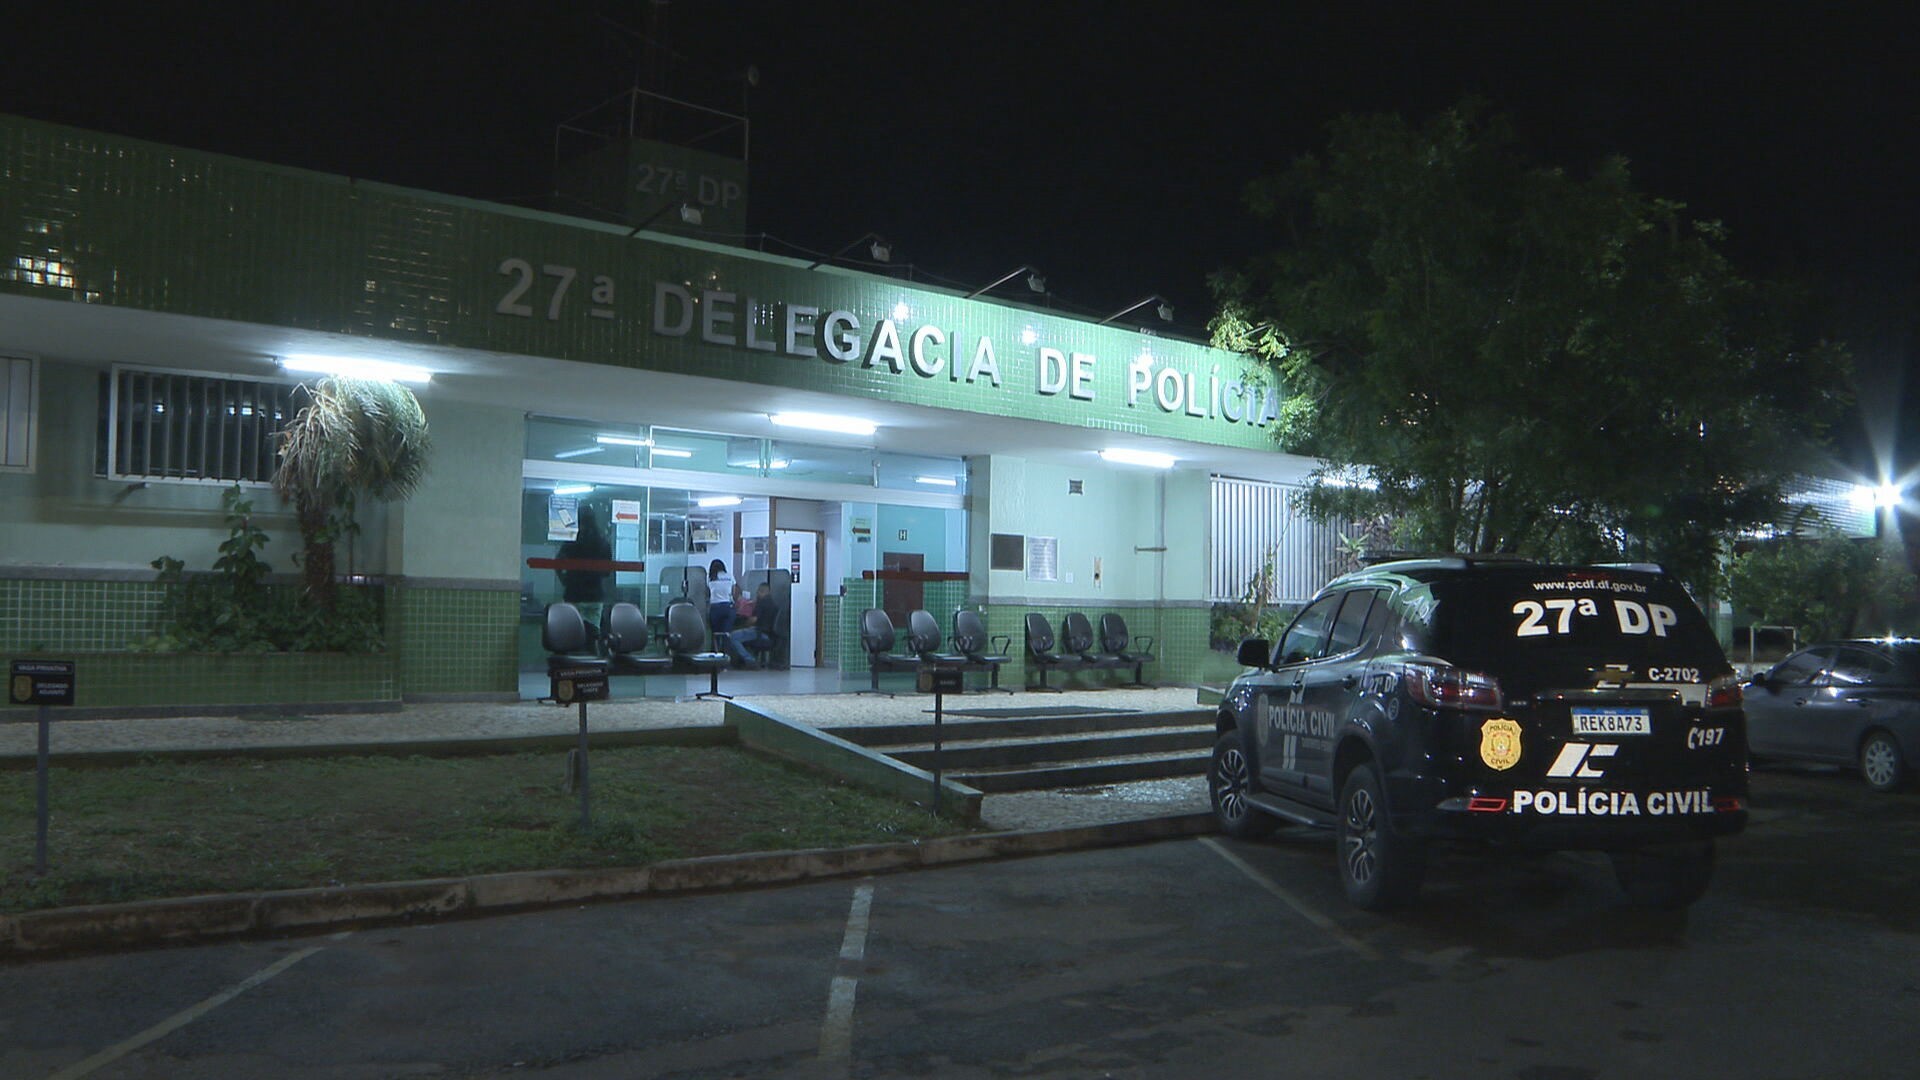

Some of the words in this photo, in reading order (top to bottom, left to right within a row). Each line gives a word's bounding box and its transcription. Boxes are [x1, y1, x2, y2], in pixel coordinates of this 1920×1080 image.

[635, 161, 688, 194] 27ª
[699, 175, 742, 208] DP
[496, 257, 615, 321] 27ª
[653, 280, 1001, 387] DELEGACIA
[1037, 346, 1097, 400] DE
[1128, 361, 1280, 427] POLÍCIA
[1532, 579, 1648, 593] www.pcdf.df.gov.br
[1512, 598, 1598, 637] 27ª
[1614, 599, 1678, 637] DP
[1648, 667, 1700, 682] C-2702
[1268, 702, 1308, 734] POLÍCIA
[1489, 723, 1514, 732] POLÍCIA
[1580, 716, 1643, 731] REK8A73
[1697, 727, 1724, 746] 197
[1513, 787, 1641, 815] POLÍCIA
[1647, 789, 1715, 814] CIVIL
